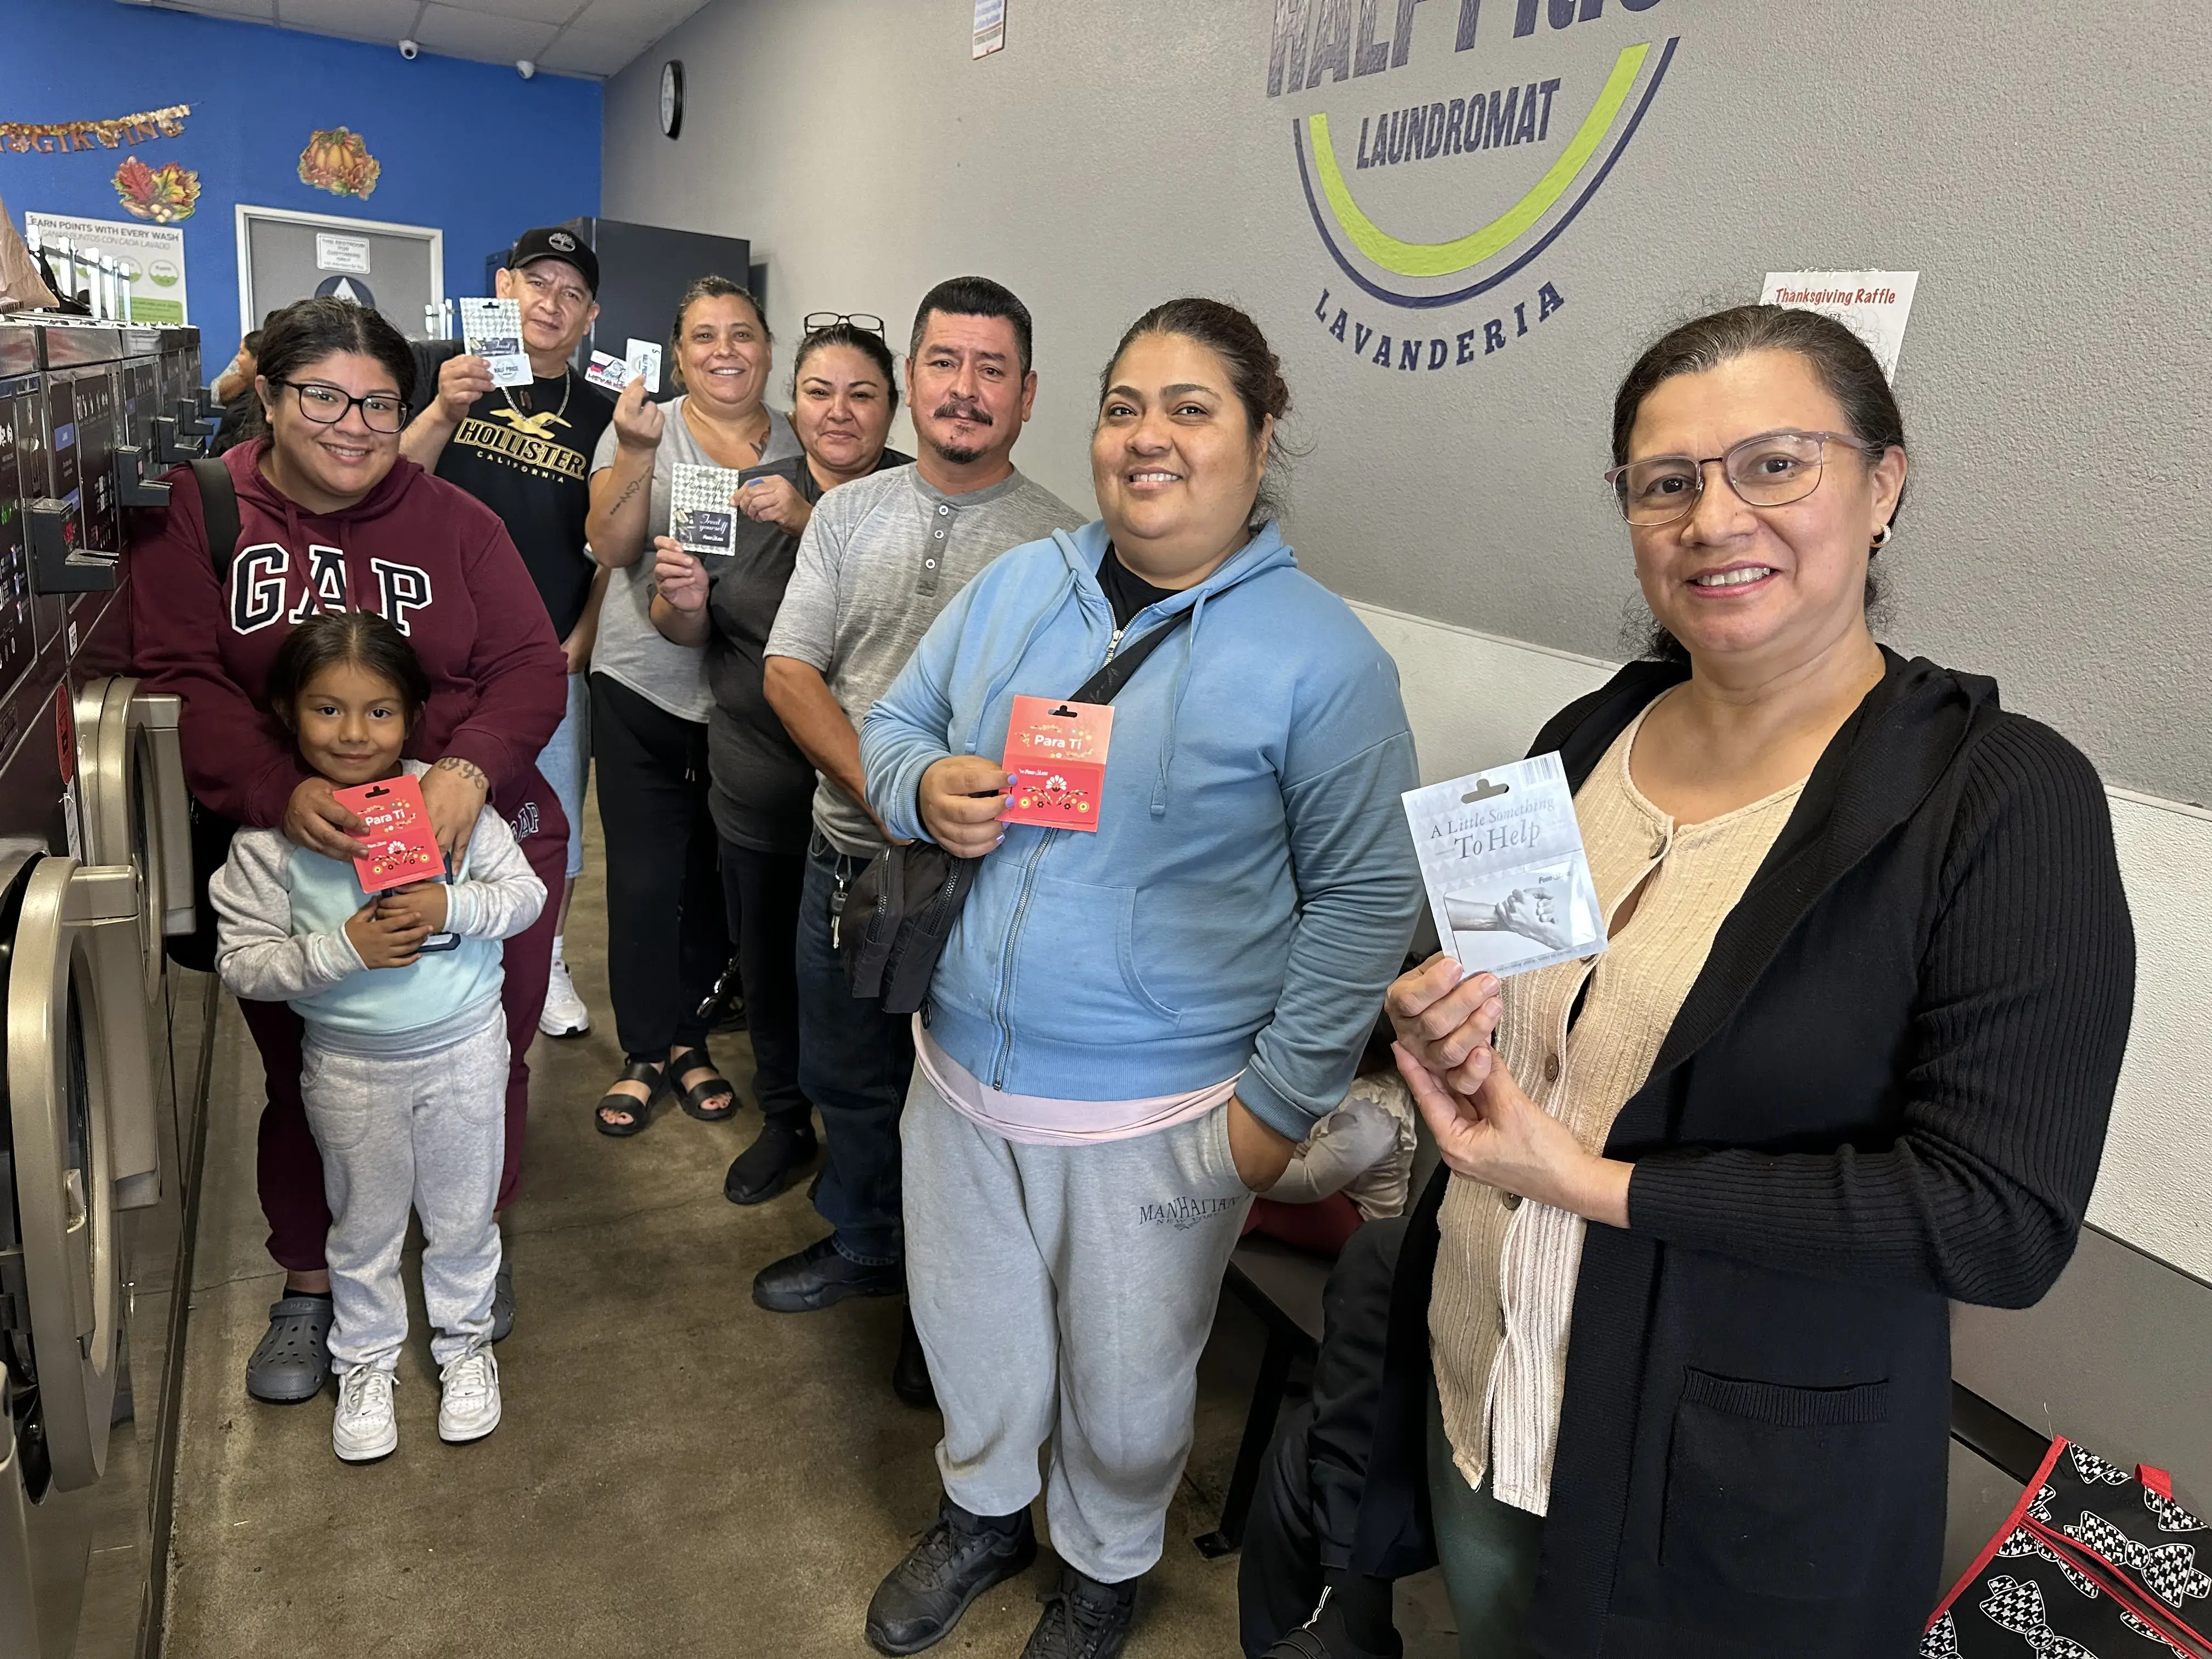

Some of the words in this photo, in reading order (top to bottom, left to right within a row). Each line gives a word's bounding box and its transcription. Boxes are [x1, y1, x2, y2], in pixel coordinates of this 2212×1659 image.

[1357, 77, 1561, 170] LAUNDROMAT
[31, 218, 57, 229] EARN
[59, 221, 93, 232] POINTS
[95, 226, 119, 236] WITH
[121, 229, 148, 239] EVERY
[153, 232, 179, 241] WASH
[1776, 288, 1853, 306] Thanksgiving
[1854, 288, 1895, 304] Raffle
[1314, 281, 1565, 371] LAVANDERIA
[454, 417, 586, 480] HOLLISTER
[476, 450, 564, 483] CALIFORNIA
[698, 522, 729, 534] yourself
[700, 513, 721, 525] Treat
[230, 543, 432, 637] GAP
[1034, 734, 1066, 748] Para
[1068, 738, 1082, 749] Ti
[365, 814, 393, 827] Para
[392, 809, 405, 820] Ti
[1431, 825, 1442, 839] A
[1448, 812, 1486, 834] Little
[1489, 797, 1555, 823] Something
[1454, 833, 1483, 860] To
[1487, 819, 1541, 852] Help
